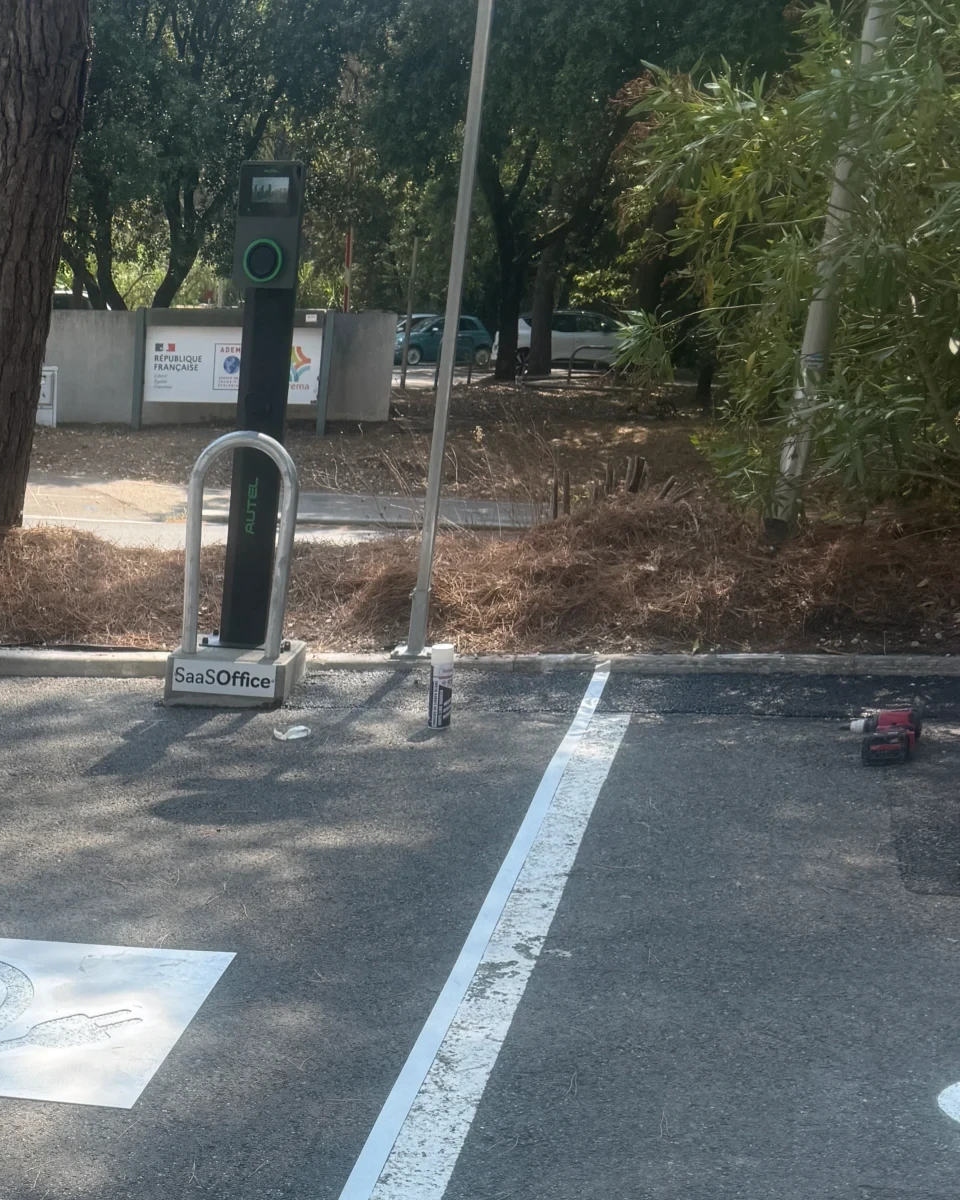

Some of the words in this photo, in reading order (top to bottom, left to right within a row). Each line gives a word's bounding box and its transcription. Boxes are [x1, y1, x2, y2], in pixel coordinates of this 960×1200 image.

[154, 354, 202, 363] RÉPUBLIQUE
[154, 363, 199, 372] FRANÇAISE
[245, 476, 259, 535] AUTEL
[174, 666, 271, 689] SaaSOffice
